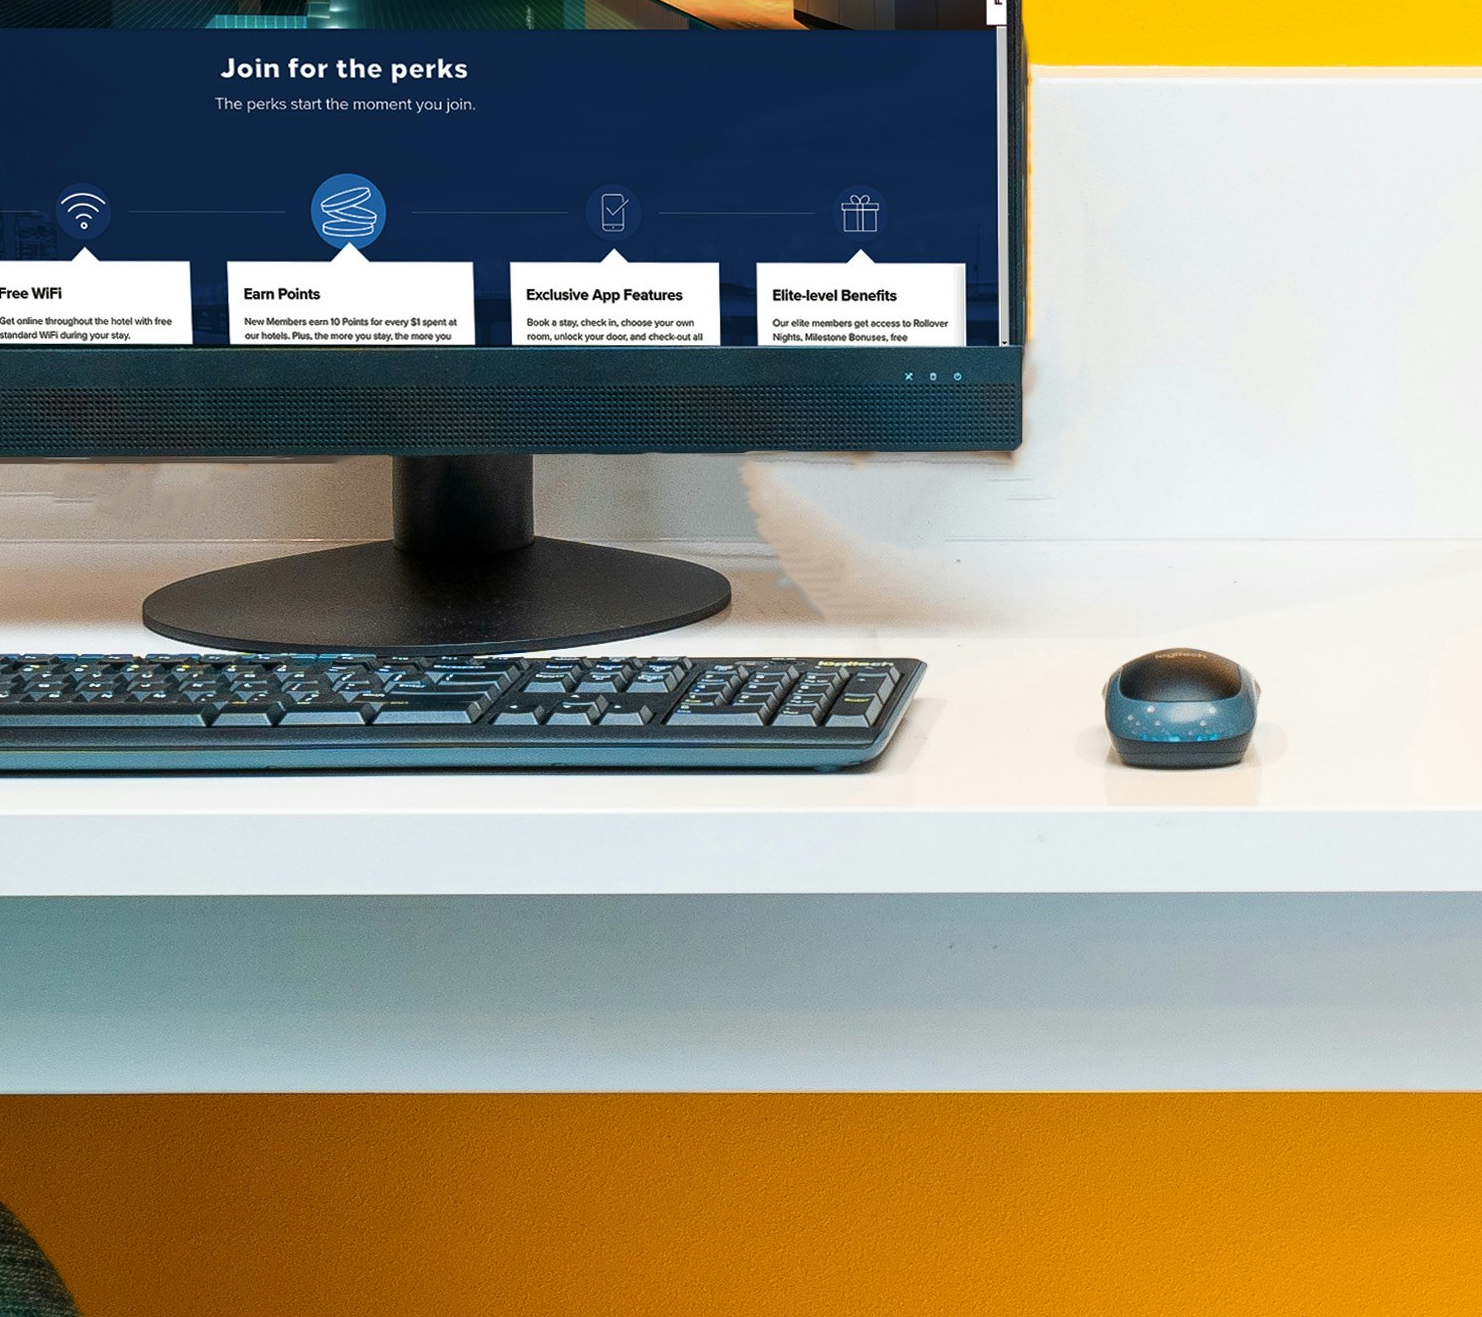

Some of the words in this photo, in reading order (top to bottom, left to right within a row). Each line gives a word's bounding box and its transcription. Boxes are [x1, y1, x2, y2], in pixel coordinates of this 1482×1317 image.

[220, 57, 280, 79] Join
[287, 57, 329, 79] for
[335, 58, 383, 79] the
[391, 58, 468, 84] perks
[214, 97, 243, 110] The
[247, 97, 287, 113] perks
[290, 98, 323, 111] start
[325, 97, 349, 110] the
[353, 98, 413, 111] moment
[415, 100, 443, 114] you
[445, 97, 476, 114] join.
[30, 286, 63, 300] WiFi
[243, 287, 275, 301] Earn
[277, 287, 321, 301] Points
[526, 287, 590, 301] Exclusive
[591, 288, 621, 304] App
[623, 288, 684, 302] Features
[772, 288, 838, 302] Elite-level
[841, 288, 898, 302] Benefits
[16, 316, 44, 326] online
[44, 316, 94, 328] throughout
[94, 316, 110, 326] the
[110, 316, 133, 326] hotel
[134, 316, 153, 326] with
[154, 316, 173, 326] free
[244, 317, 265, 326] New
[265, 317, 308, 327] Members
[308, 319, 329, 327] earn
[330, 317, 341, 327] 10
[341, 317, 370, 327] Points
[370, 317, 384, 327] for
[384, 319, 410, 328] every
[410, 317, 421, 327] $1
[421, 318, 448, 328] spent
[447, 318, 458, 327] at
[526, 317, 550, 327] Book
[551, 319, 558, 327] a
[580, 318, 608, 327] check
[620, 318, 653, 328] choose
[653, 320, 675, 329] your
[675, 319, 695, 328] own
[771, 318, 790, 328] Our
[790, 318, 811, 328] elite
[811, 318, 853, 328] members
[853, 319, 870, 330] get
[870, 320, 901, 328] access
[901, 319, 912, 328] to
[912, 318, 949, 328] Rollover
[0, 330, 38, 340] standard
[38, 330, 59, 340] WiFi
[59, 330, 89, 342] during
[89, 332, 110, 342] your
[244, 332, 260, 341] our
[313, 331, 330, 341] the
[330, 332, 354, 341] more
[354, 333, 372, 343] you
[394, 331, 410, 341] the
[410, 332, 434, 341] more
[434, 333, 452, 343] you
[553, 332, 584, 342] unlock
[584, 333, 605, 343] your
[629, 332, 647, 342] and
[647, 332, 692, 342] check-out
[692, 332, 704, 342] all
[804, 332, 848, 342] Milestone
[889, 332, 909, 342] free
